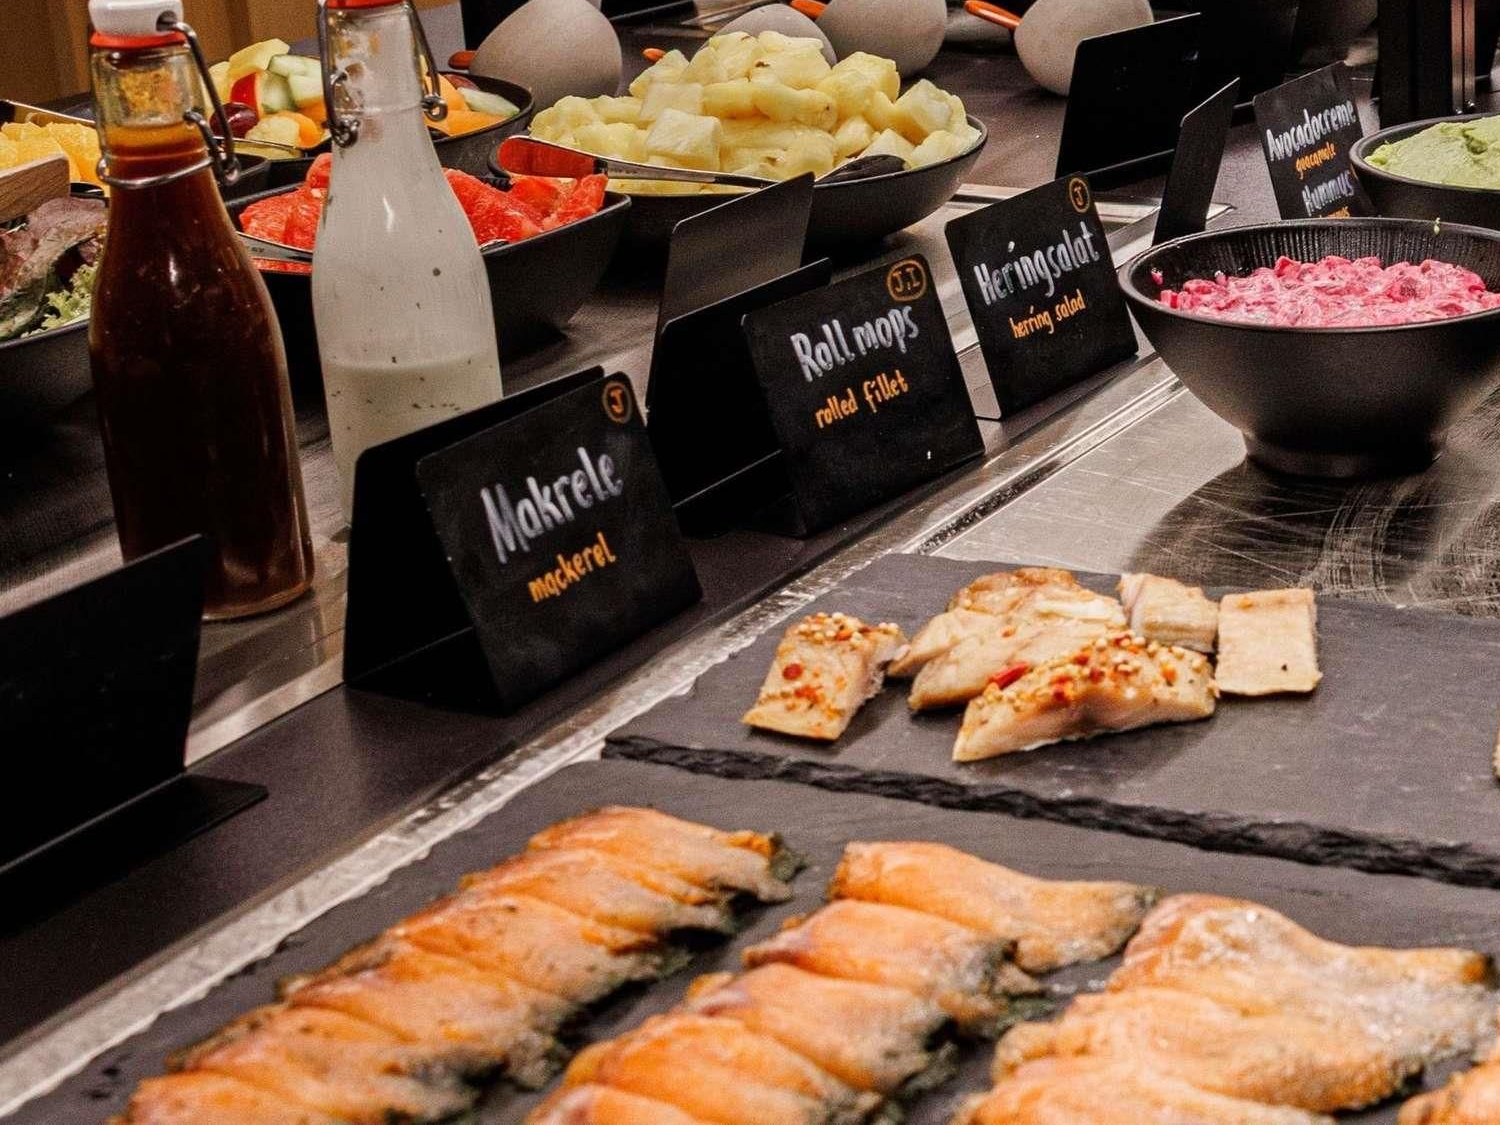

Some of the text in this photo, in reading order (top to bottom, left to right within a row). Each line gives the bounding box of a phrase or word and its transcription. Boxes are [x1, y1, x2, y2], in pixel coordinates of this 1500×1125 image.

[1265, 98, 1358, 162] Avocadocreme
[1301, 170, 1355, 217] Hummus
[972, 220, 1100, 306] Heringsalat
[1008, 288, 1087, 339] herring salad
[815, 368, 909, 429] rolled fillet
[479, 446, 625, 565] Makrele
[527, 531, 617, 604] mackerel
